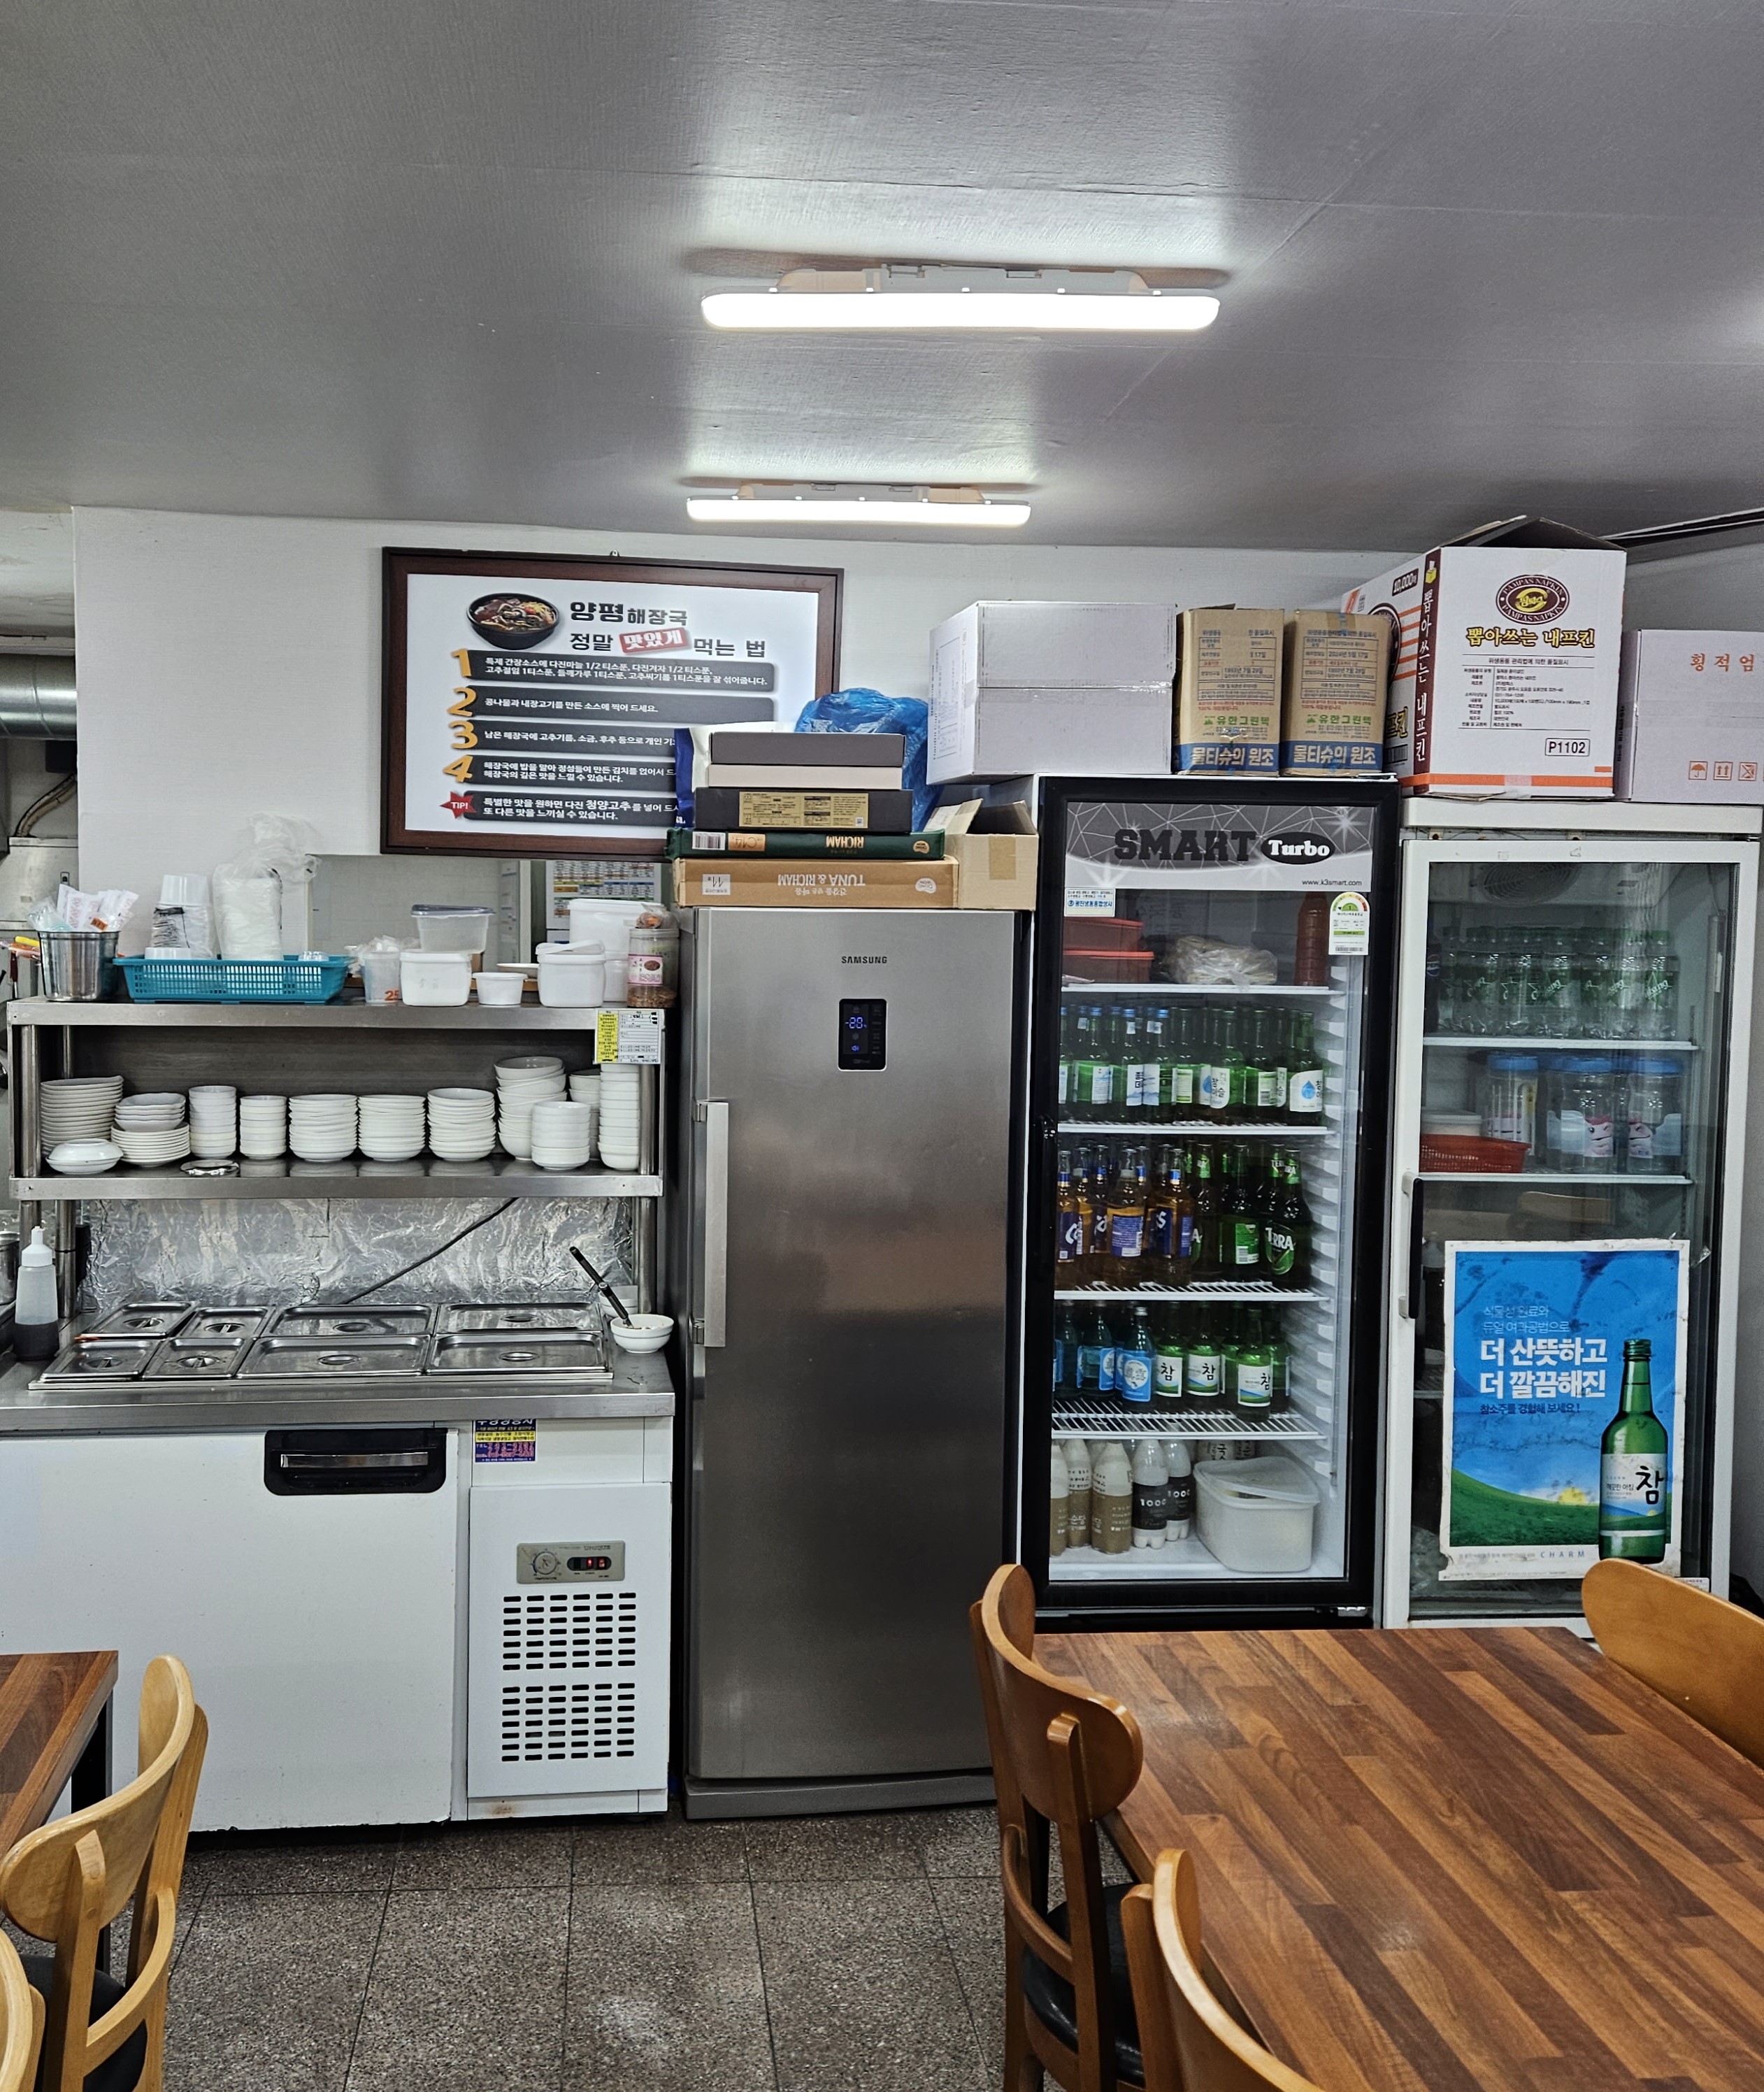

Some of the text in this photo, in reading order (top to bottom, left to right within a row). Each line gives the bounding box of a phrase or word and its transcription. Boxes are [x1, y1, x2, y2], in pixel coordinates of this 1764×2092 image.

[1503, 578, 1563, 595] PAMPAS NAPKIN
[1502, 605, 1564, 621] PAMPAS NAPKIN
[570, 629, 766, 657] 정말 맛있게 먹는 법
[1466, 626, 1596, 648] 뽑아쓰는 내프킨
[451, 648, 472, 678] 1
[505, 658, 548, 668] 간장소스에
[549, 660, 583, 669] 다진마늘
[1691, 653, 1764, 672] 횡적엄
[485, 666, 519, 675] 고추절임
[557, 669, 591, 678] 들깨가루
[673, 674, 711, 683] 1티스푼을
[712, 675, 721, 684] 잘
[1415, 589, 1433, 761] 뽑아쓰는 내프킨
[447, 687, 477, 717] 2
[485, 698, 659, 712] 콩나물과 내장고기를 만든 소스에 찍어 드세요.
[448, 719, 478, 750] 3
[485, 731, 502, 739] 남은
[503, 732, 538, 740] 해장국에
[599, 735, 617, 744] 후추
[618, 736, 643, 745] 등으로
[645, 736, 662, 745] 개인
[1294, 745, 1376, 764] 물티슈의 원조
[1549, 740, 1586, 754] P1102
[1193, 747, 1274, 766] 물티슈의 원조
[443, 754, 473, 783] 4
[484, 762, 519, 771] 해장국에
[520, 763, 538, 772] 밥을
[539, 764, 556, 772] 말아
[558, 764, 591, 773] 정성들여
[594, 766, 611, 775] 만든
[612, 766, 638, 775] 김치를
[484, 770, 519, 779] 해장국의
[519, 771, 538, 780] 깊은
[539, 772, 556, 780] 맛을
[557, 773, 575, 781] 느낄
[587, 774, 623, 783] 있습니다.
[451, 801, 468, 810] TIP!
[484, 798, 512, 807] 특별한
[514, 798, 533, 808] 맛을
[535, 799, 563, 809] 원하면
[565, 801, 584, 810] 다진
[643, 803, 661, 812] 넣어
[484, 807, 618, 820] 또 다른 맛을 느끼실 수 있습니다.
[826, 836, 864, 848] RICHAM
[1114, 828, 1330, 861] SMART Turbo
[777, 873, 866, 886] TUNA & RICHAM
[1480, 1337, 1608, 1367] 더 산뜻하고
[1161, 1363, 1175, 1381] 참
[1202, 1363, 1217, 1381] 참
[1261, 1373, 1270, 1390] 참
[1479, 1369, 1606, 1399] 더 깔끔해진
[1479, 1403, 1516, 1415] 참소주를
[1635, 1466, 1665, 1505] 참
